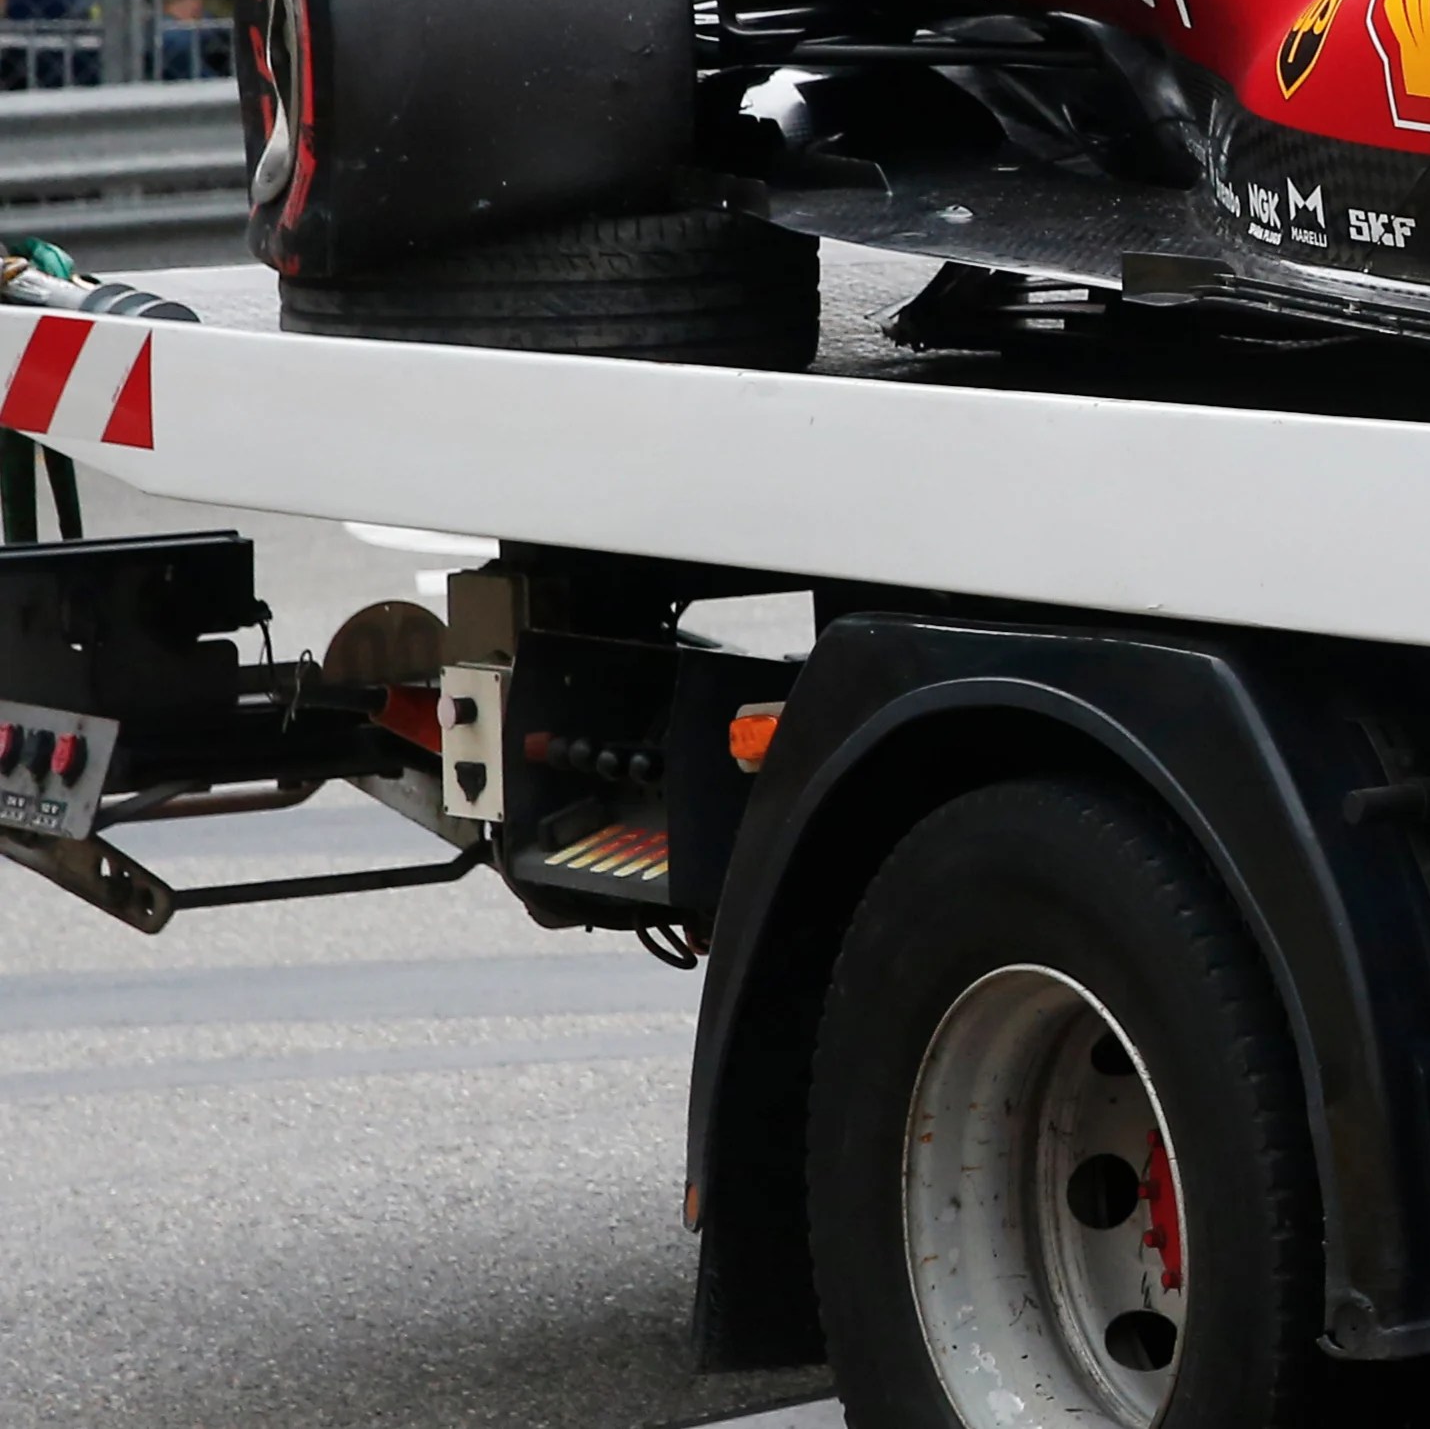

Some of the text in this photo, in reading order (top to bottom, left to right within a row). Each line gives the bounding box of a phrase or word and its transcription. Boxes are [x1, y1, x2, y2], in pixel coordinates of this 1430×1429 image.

[1247, 181, 1282, 229] NGK
[1290, 226, 1328, 248] MARELLI
[1348, 208, 1417, 248] SKF
